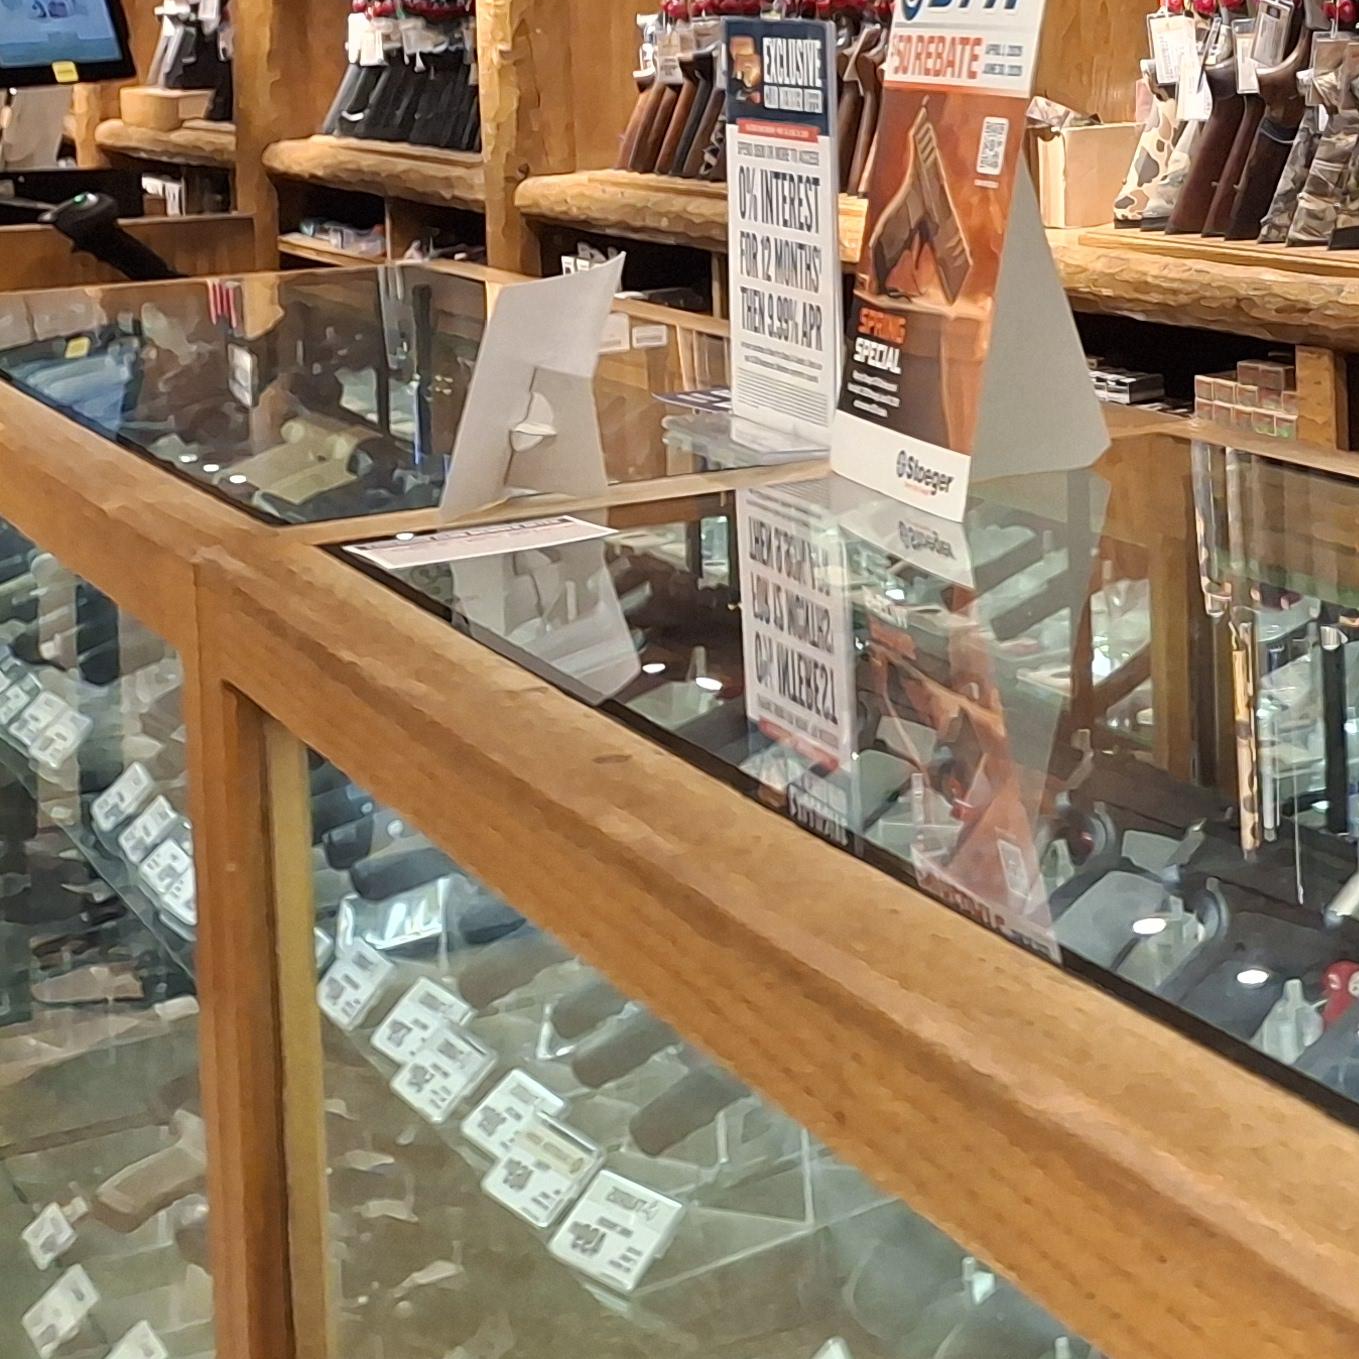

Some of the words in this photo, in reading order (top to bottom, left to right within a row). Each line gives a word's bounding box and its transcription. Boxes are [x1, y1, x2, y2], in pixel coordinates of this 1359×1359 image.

[763, 37, 822, 87] EXCLUSIVE
[912, 36, 982, 80] REBATE
[738, 165, 757, 222] 0%
[760, 168, 821, 234] INTEREST
[740, 230, 758, 279] FOR
[760, 235, 772, 283] 12
[740, 286, 765, 335] THEN
[767, 293, 799, 345] 9.99%
[801, 301, 823, 352] APR
[853, 337, 902, 374] SPECIAL
[907, 454, 956, 496] Stoeger
